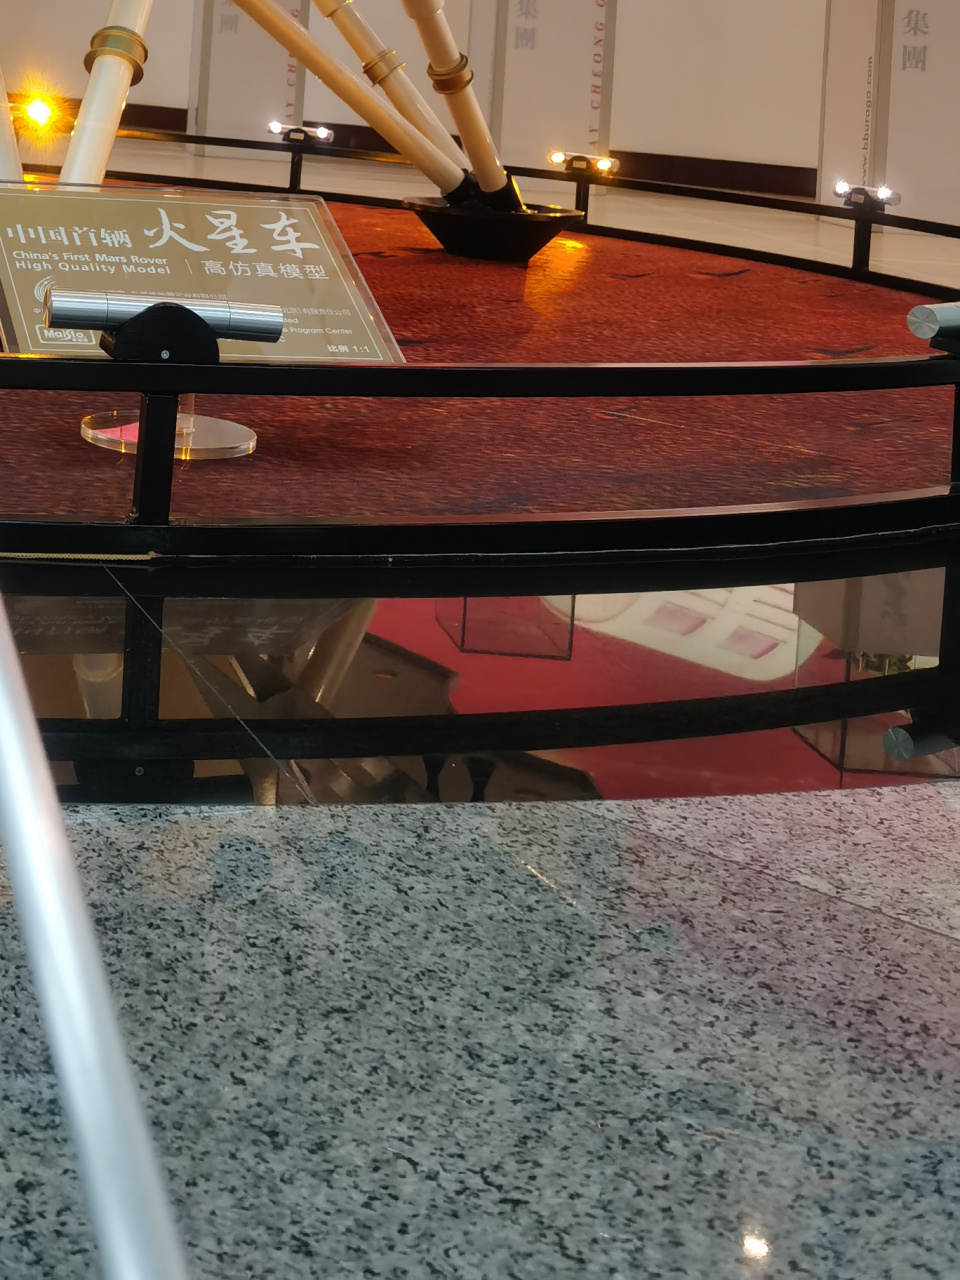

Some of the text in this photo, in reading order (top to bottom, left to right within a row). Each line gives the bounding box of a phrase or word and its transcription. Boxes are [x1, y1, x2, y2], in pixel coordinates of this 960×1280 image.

[6, 207, 321, 259] 中国首辆 火星车
[12, 250, 168, 265] China's First Mars Rover
[15, 261, 171, 275] High Quality Model
[200, 259, 330, 280] 高仿真模型
[43, 329, 85, 340] Maisto
[289, 327, 325, 335] Program
[352, 345, 370, 353] 1:1
